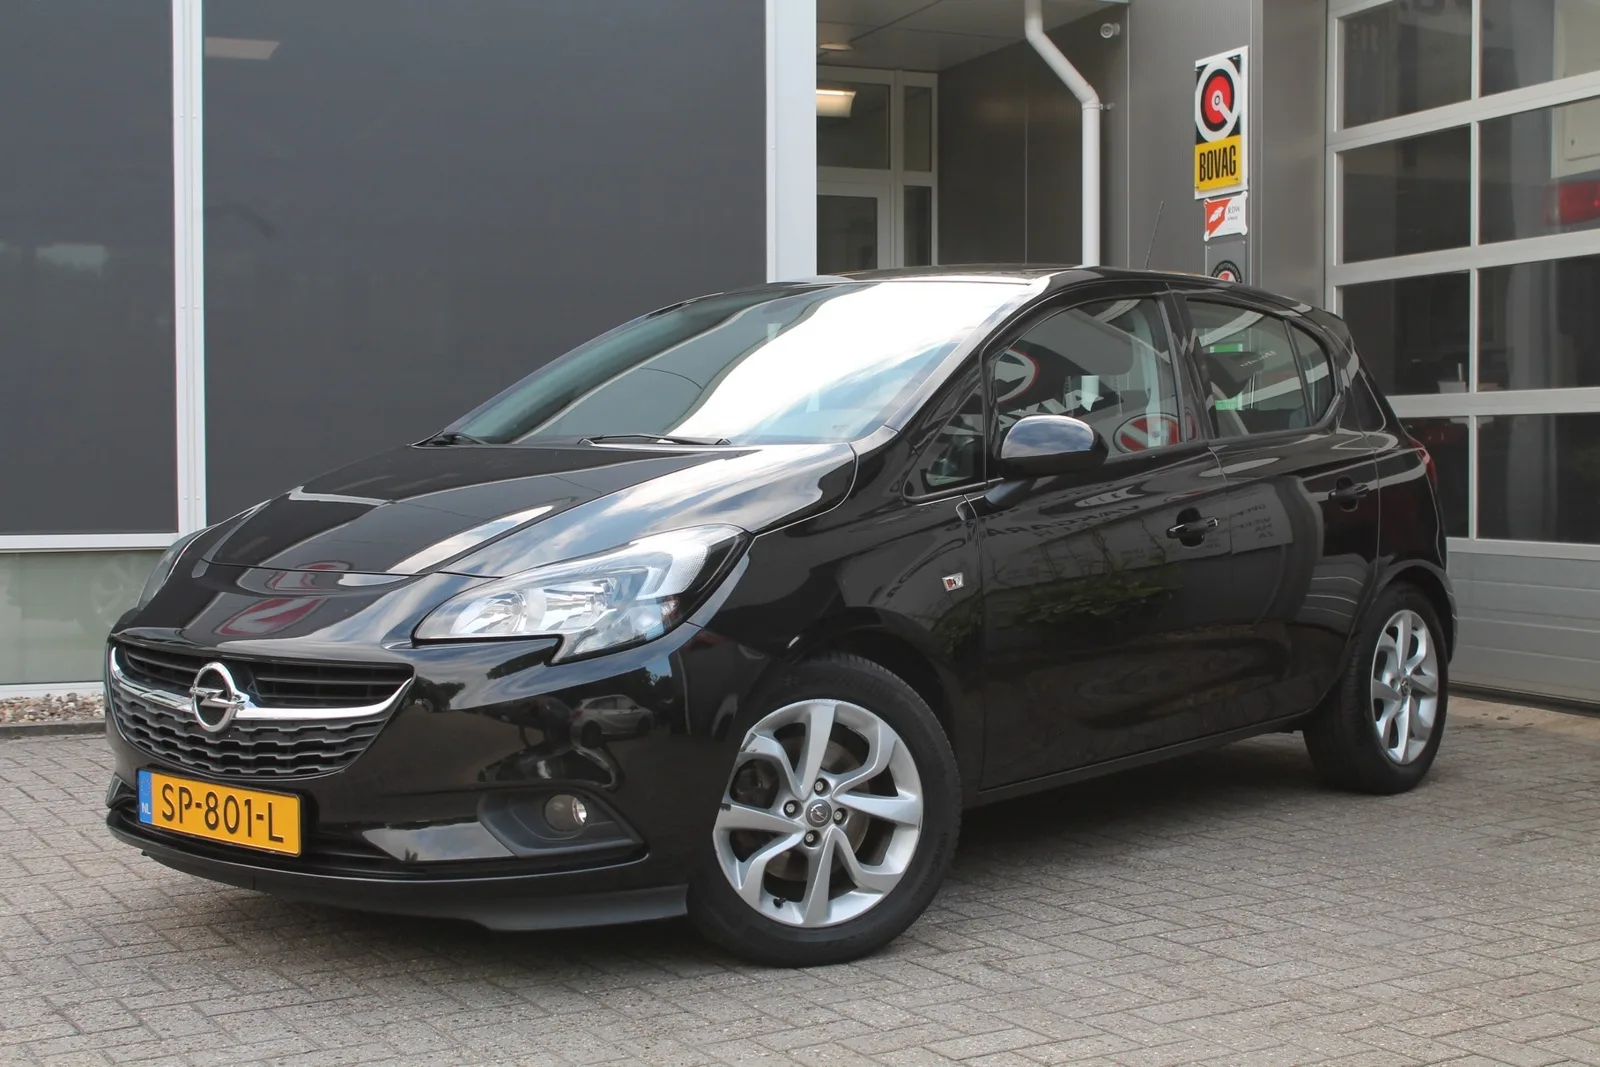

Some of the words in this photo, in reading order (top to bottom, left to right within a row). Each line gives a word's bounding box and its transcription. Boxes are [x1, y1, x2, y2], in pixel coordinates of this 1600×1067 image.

[1199, 145, 1237, 182] BOVAG
[141, 802, 151, 814] NL
[162, 783, 284, 843] SP-801-L
